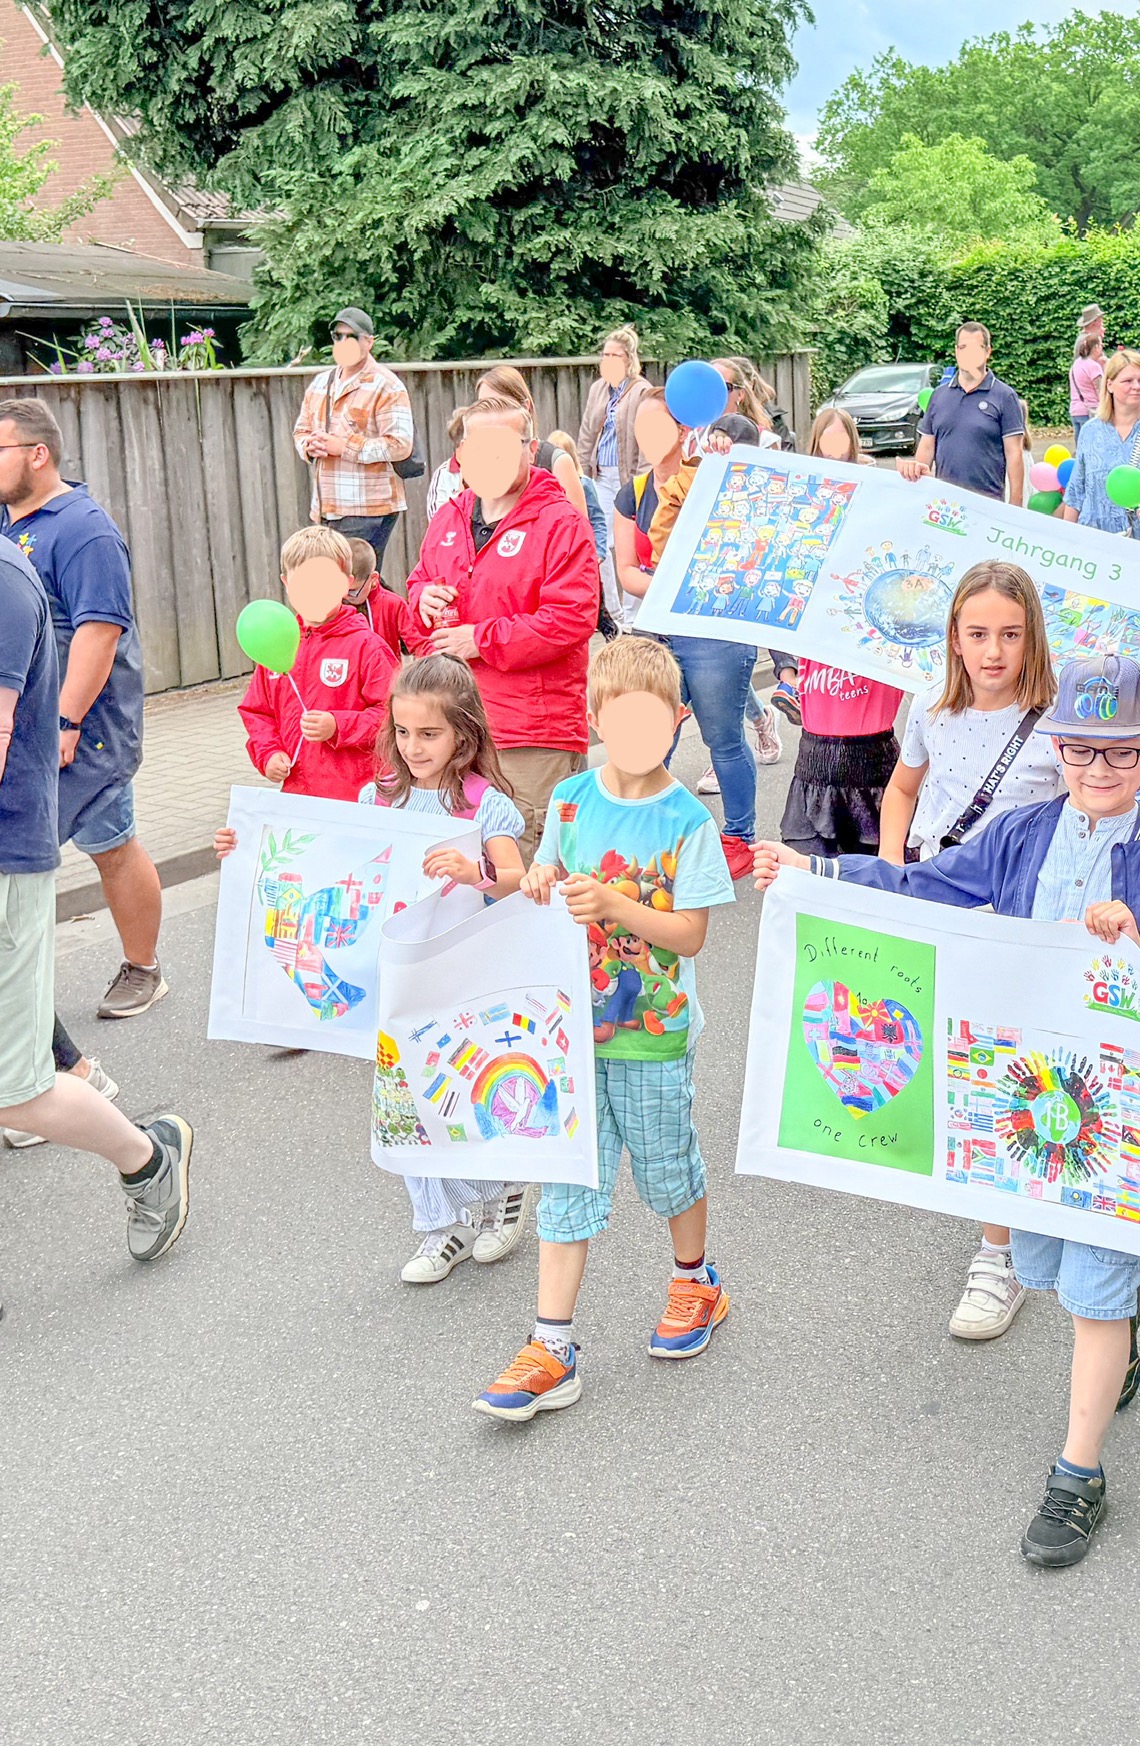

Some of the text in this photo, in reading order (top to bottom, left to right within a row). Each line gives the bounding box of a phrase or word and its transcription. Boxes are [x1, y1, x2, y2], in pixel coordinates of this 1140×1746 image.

[928, 509, 962, 529] GSW
[986, 526, 1123, 581] Jahrgang 3
[839, 684, 869, 702] teens
[1001, 734, 1024, 774] RIGHT
[803, 936, 922, 994] Different roots
[1092, 981, 1136, 1009] GSW
[1045, 1100, 1069, 1131] 1B
[813, 1119, 842, 1142] one
